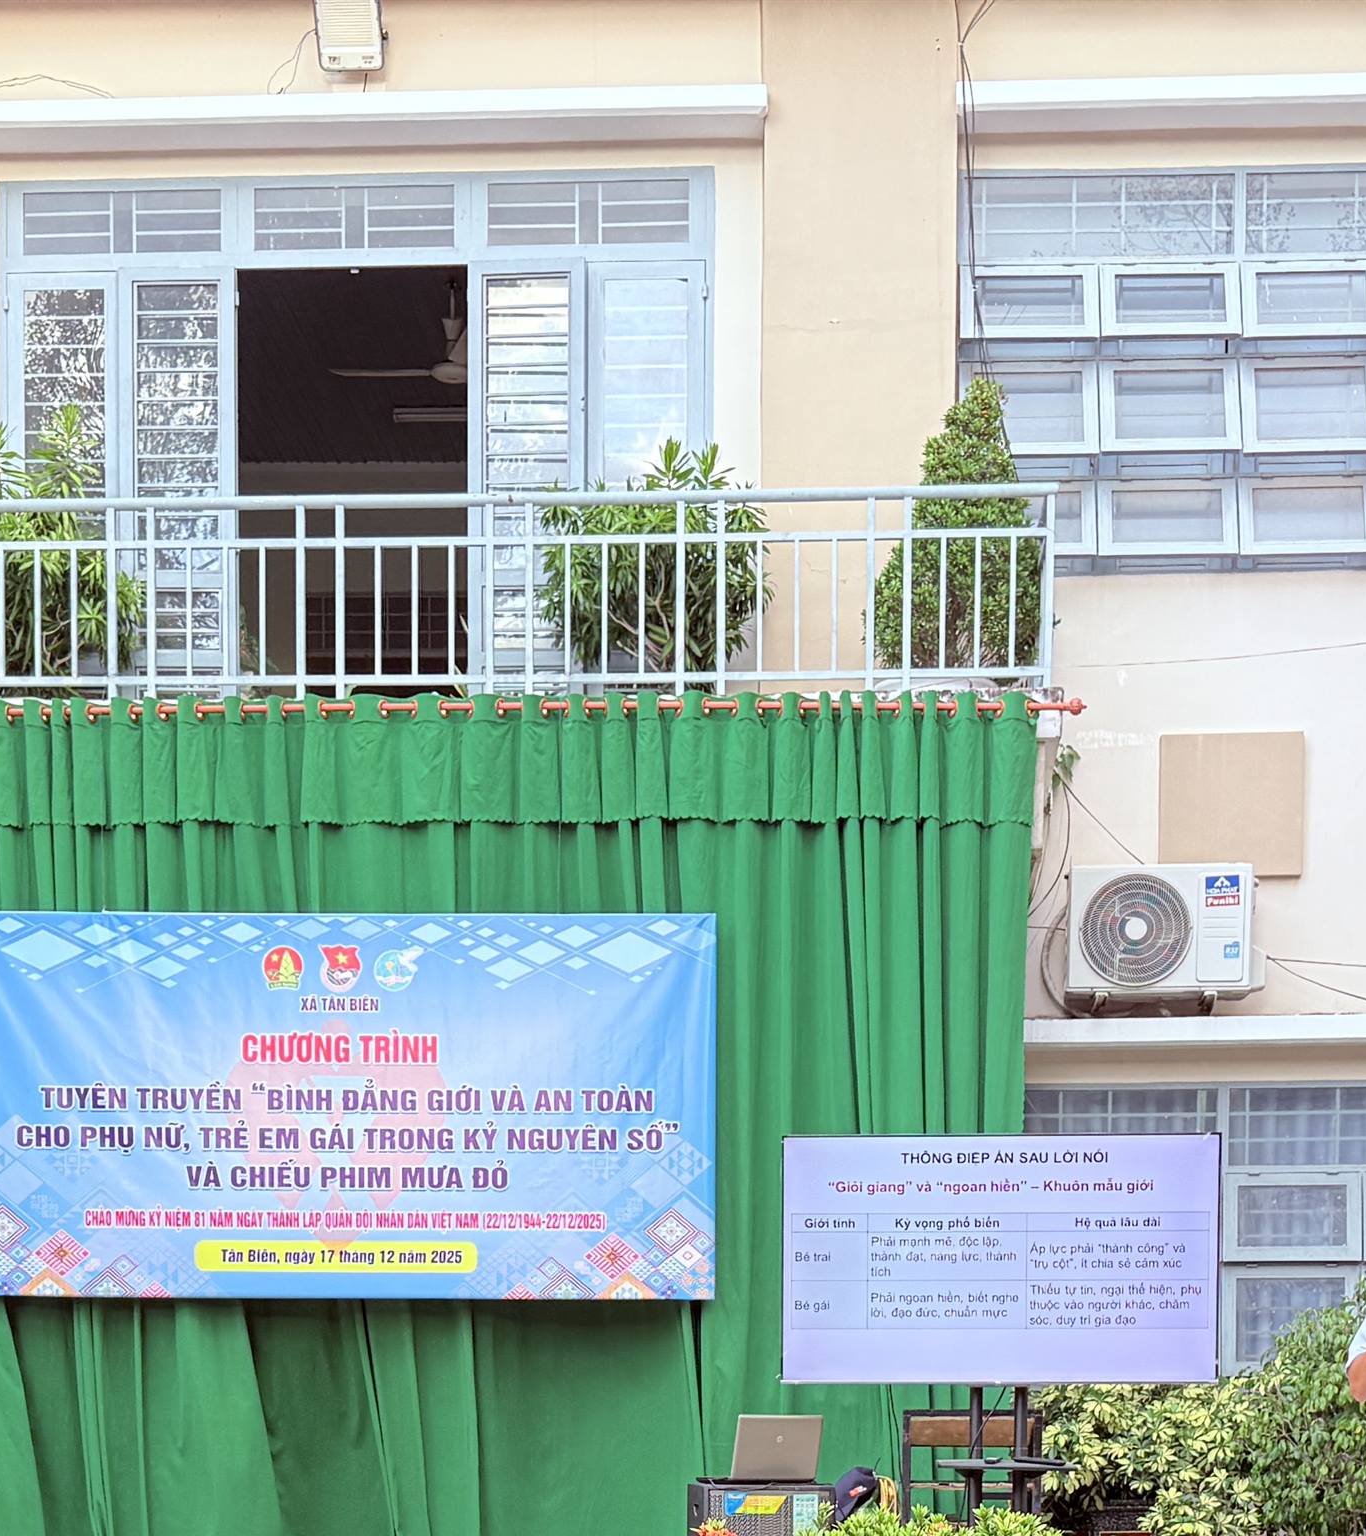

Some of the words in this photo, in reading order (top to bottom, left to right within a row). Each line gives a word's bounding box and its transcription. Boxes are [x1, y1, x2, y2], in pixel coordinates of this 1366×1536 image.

[322, 997, 346, 1011] TÂN
[350, 998, 379, 1011] BIÊN
[242, 1032, 350, 1064] CHƯƠNG
[359, 1030, 438, 1064] TRÌNH
[41, 1083, 127, 1109] TUYÊN
[137, 1081, 241, 1110] TRUYỀN
[342, 1079, 416, 1112] ĐẲNG
[428, 1085, 480, 1112] GIỚI
[491, 1086, 525, 1111] VÀ
[535, 1090, 572, 1112] AN
[581, 1086, 653, 1112] TOÀN
[16, 1125, 70, 1148] CHO
[81, 1126, 134, 1155] PHỤ
[144, 1123, 190, 1151] NỮ,
[200, 1120, 248, 1149] TRẺ
[259, 1127, 299, 1149] EM
[310, 1123, 353, 1150] GÁI
[364, 1127, 453, 1150] TRONG
[464, 1121, 498, 1150] KỶ
[508, 1124, 617, 1150] NGUYÊN
[901, 1150, 953, 1164] THÔNG
[1019, 1151, 1049, 1164] SAU
[1053, 1149, 1079, 1164] LỜI
[1083, 1149, 1108, 1164] NÓI
[187, 1161, 221, 1187] VÀ
[230, 1159, 310, 1188] CHIẾU
[321, 1166, 391, 1188] PHIM
[402, 1165, 463, 1188] MƯA
[473, 1160, 508, 1189] ĐỎ
[221, 1248, 244, 1263] Tân
[284, 1249, 314, 1266] ngày
[320, 1250, 335, 1263] 17
[339, 1249, 374, 1266] tháng
[379, 1250, 395, 1264] 12
[399, 1251, 426, 1264] năm
[431, 1251, 462, 1264] 2025
